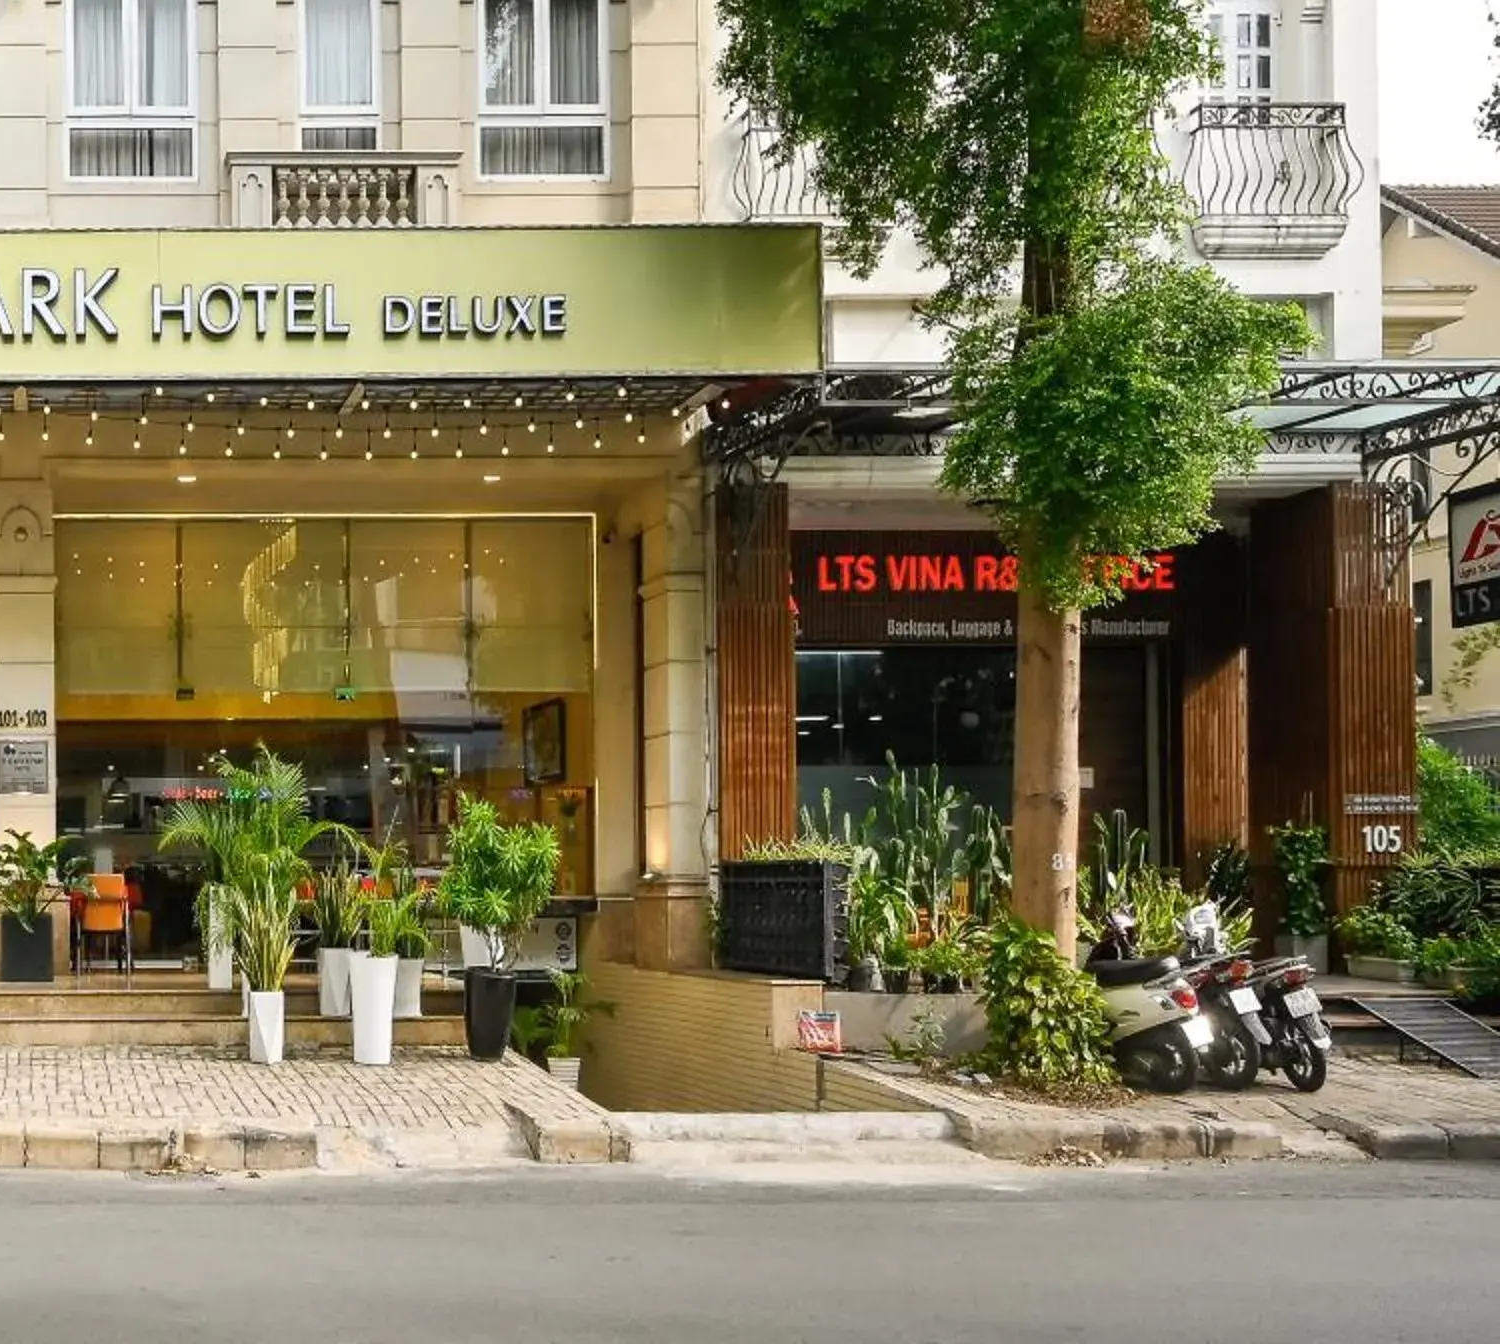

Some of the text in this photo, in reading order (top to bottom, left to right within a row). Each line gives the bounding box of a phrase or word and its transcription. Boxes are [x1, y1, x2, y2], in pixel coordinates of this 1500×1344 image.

[150, 282, 352, 343] HOTEL
[382, 295, 568, 340] DELUXE
[817, 554, 878, 592] LTS
[885, 554, 965, 592] VINA
[974, 554, 1019, 593] R&
[1456, 585, 1492, 618] LTS
[1362, 824, 1402, 854] 105
